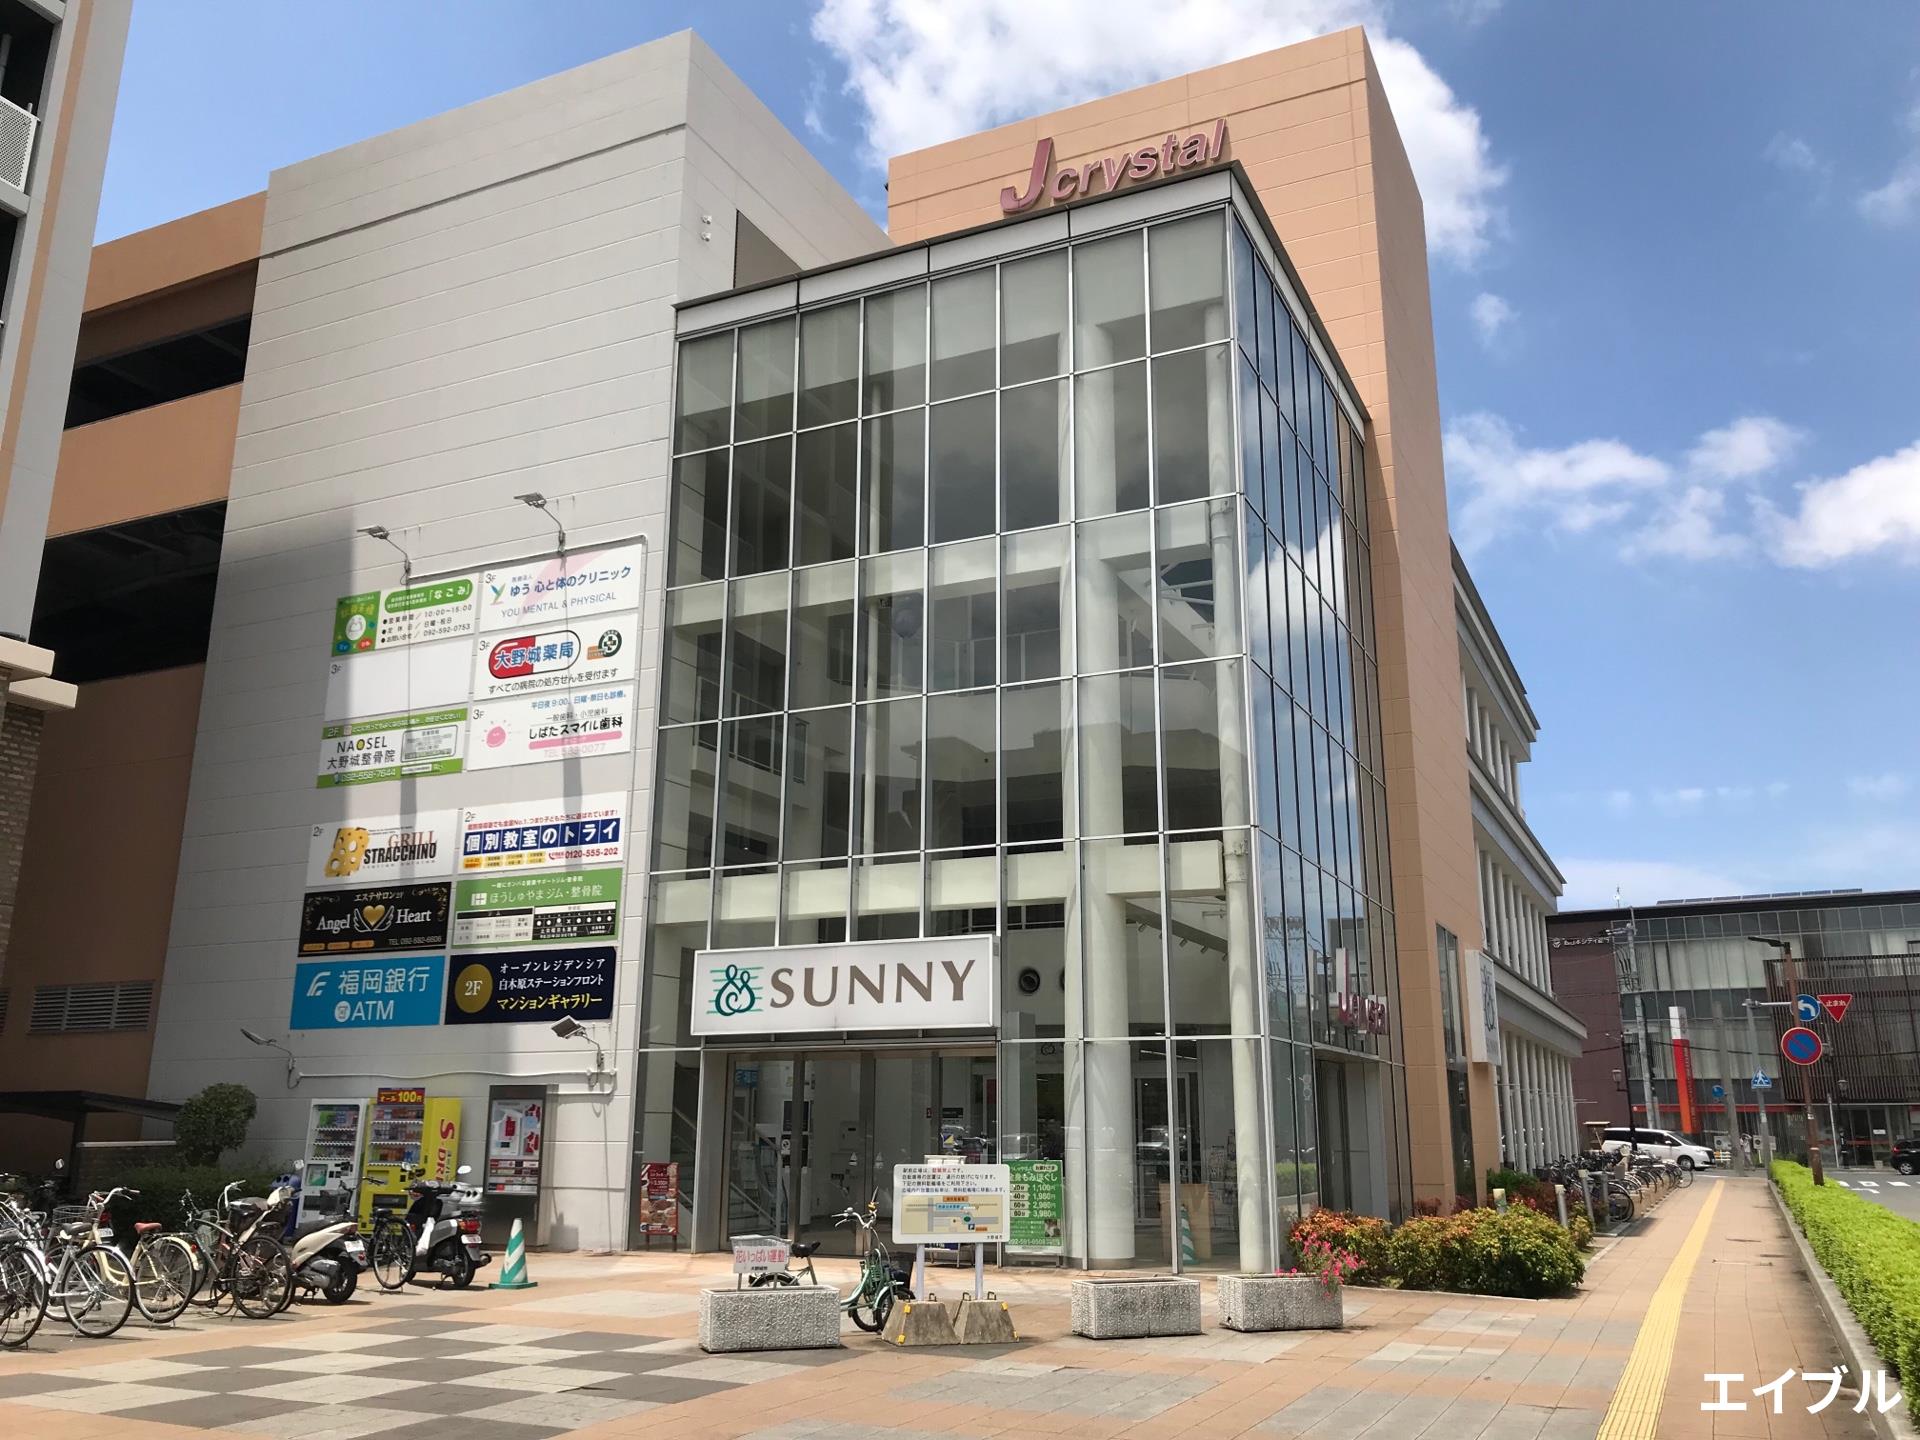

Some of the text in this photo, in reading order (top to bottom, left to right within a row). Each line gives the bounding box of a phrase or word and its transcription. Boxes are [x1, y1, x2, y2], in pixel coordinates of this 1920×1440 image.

[485, 573, 497, 584] 3F
[510, 566, 631, 597] ゆう 心と体のクリニック
[501, 592, 617, 618] YOU MENTAL & PHYSICAL
[479, 640, 490, 651] 3F
[494, 641, 574, 670] 大野城薬局
[331, 664, 343, 675] 3F
[488, 668, 618, 694] すべての病院の処方せんを受付ます
[473, 708, 485, 720] 3F
[529, 716, 623, 740] しばたスマイル歯科
[336, 736, 388, 754] NAOSEL
[327, 749, 396, 771] 大野城整骨院
[464, 811, 477, 823] 2F
[312, 826, 324, 837] 2F
[388, 830, 438, 848] GRILL
[465, 820, 618, 852] 個別教室のトライ
[363, 843, 437, 865] STRACCHINO
[565, 847, 619, 859] 0120-555-202
[316, 908, 432, 934] Angel Heart
[500, 958, 606, 974] オープンレジデンシア
[338, 966, 431, 995] 福岡銀行
[464, 980, 483, 996] 2F
[499, 974, 604, 991] 白木原ステーションフロント
[769, 959, 976, 1009] SUNNY
[351, 1000, 395, 1021] ATM
[497, 993, 603, 1011] マンションギャラリー
